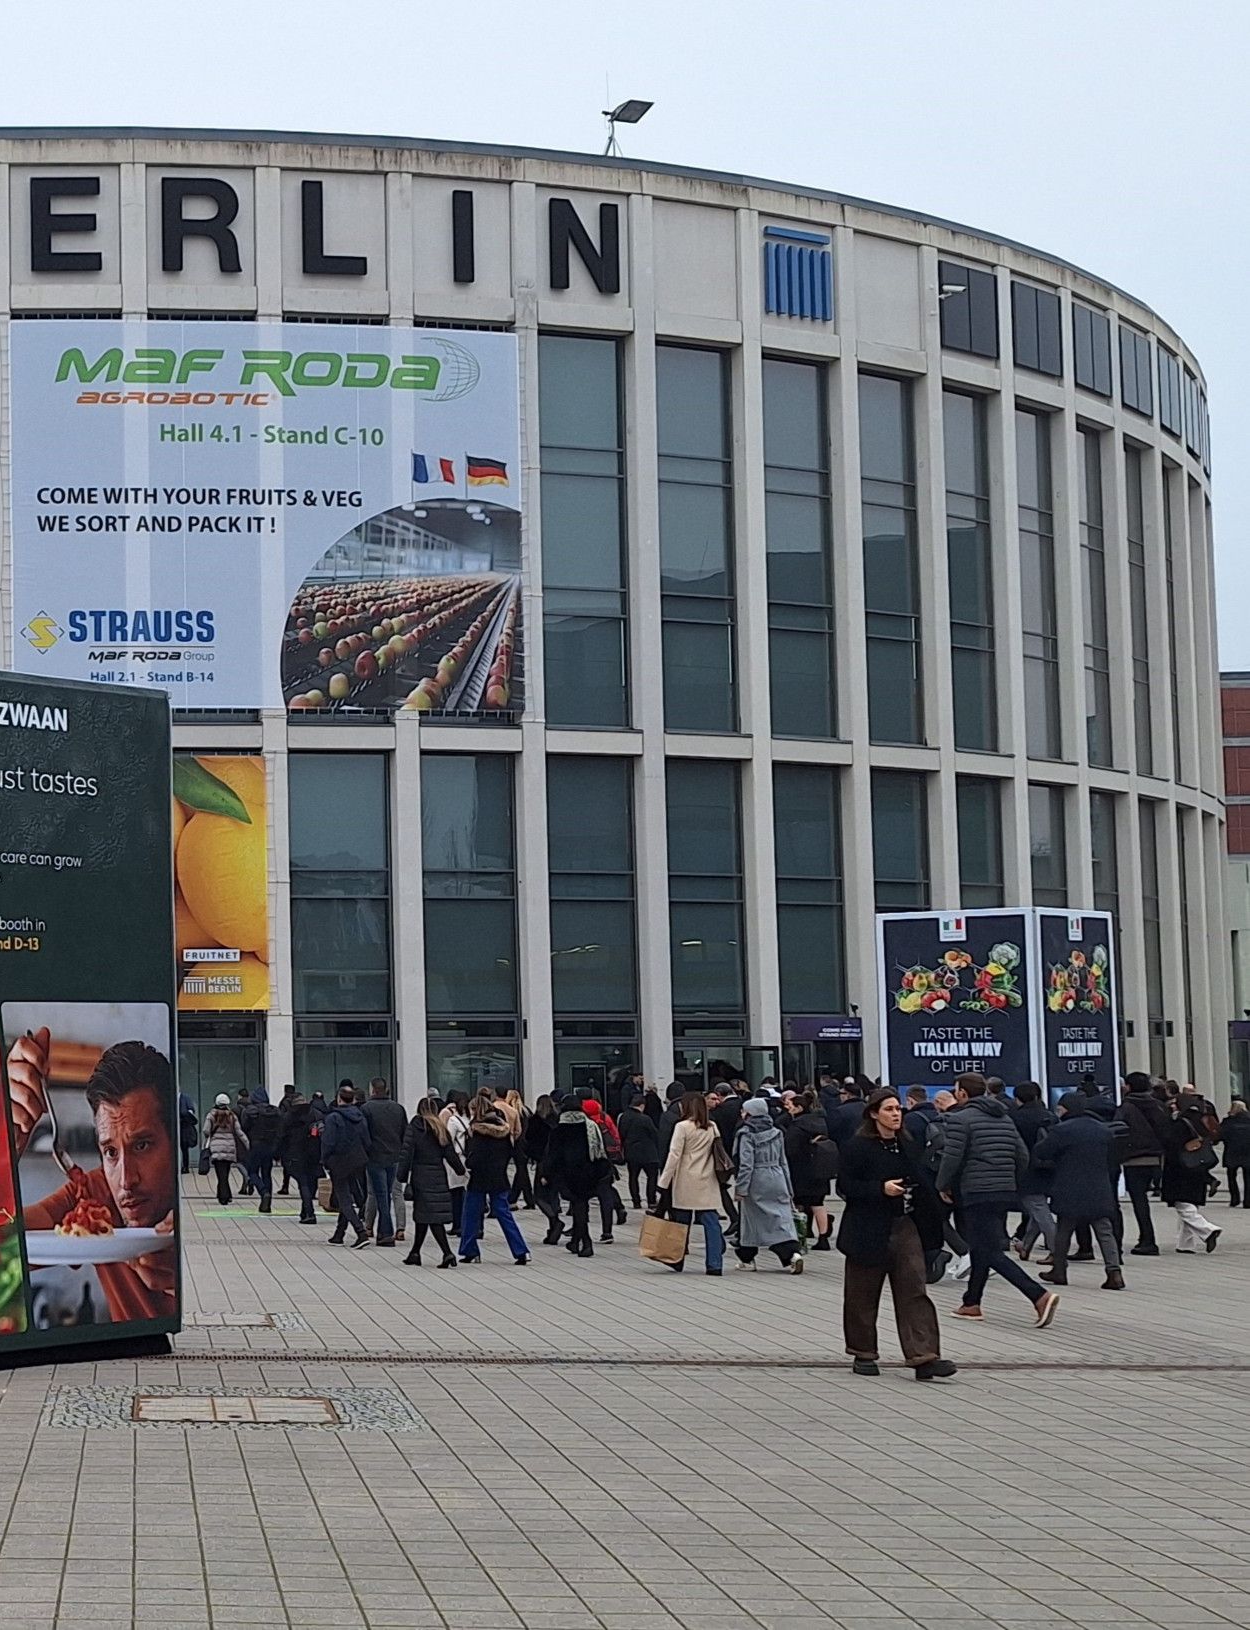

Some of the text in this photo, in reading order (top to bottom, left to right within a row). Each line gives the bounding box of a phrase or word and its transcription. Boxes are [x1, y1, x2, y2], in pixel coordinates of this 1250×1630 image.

[160, 423, 203, 442] Hall
[210, 425, 242, 443] 4.1
[264, 425, 327, 444] Stand
[335, 427, 383, 446] C-10
[36, 487, 363, 508] COME WITH YOUR FRUITS & VEG
[37, 515, 69, 532] WE
[75, 515, 130, 532] SORT
[136, 516, 182, 533] AND
[188, 516, 242, 533] PACK
[247, 516, 265, 533] IT
[68, 610, 215, 643] STRAUSS
[183, 651, 215, 662] Group
[90, 672, 114, 682] Hall
[118, 672, 135, 682] 2.1
[147, 671, 183, 682] Stand
[187, 672, 214, 682] B-14
[31, 767, 98, 797] tastes
[0, 852, 27, 864] care
[29, 853, 51, 865] can
[54, 854, 82, 870] grow
[0, 916, 33, 931] booth
[35, 918, 46, 931] in
[14, 937, 39, 950] D-13
[185, 951, 238, 959] FRUITNET
[208, 976, 241, 985] MESSE
[208, 984, 242, 993] BERLIN
[921, 1027, 992, 1040] TASTE THE
[1061, 1027, 1098, 1040] TASTE THE
[913, 1042, 1003, 1057] ITALIAN WAY
[931, 1060, 986, 1073] OF LIFE!
[1067, 1061, 1077, 1073] OF
